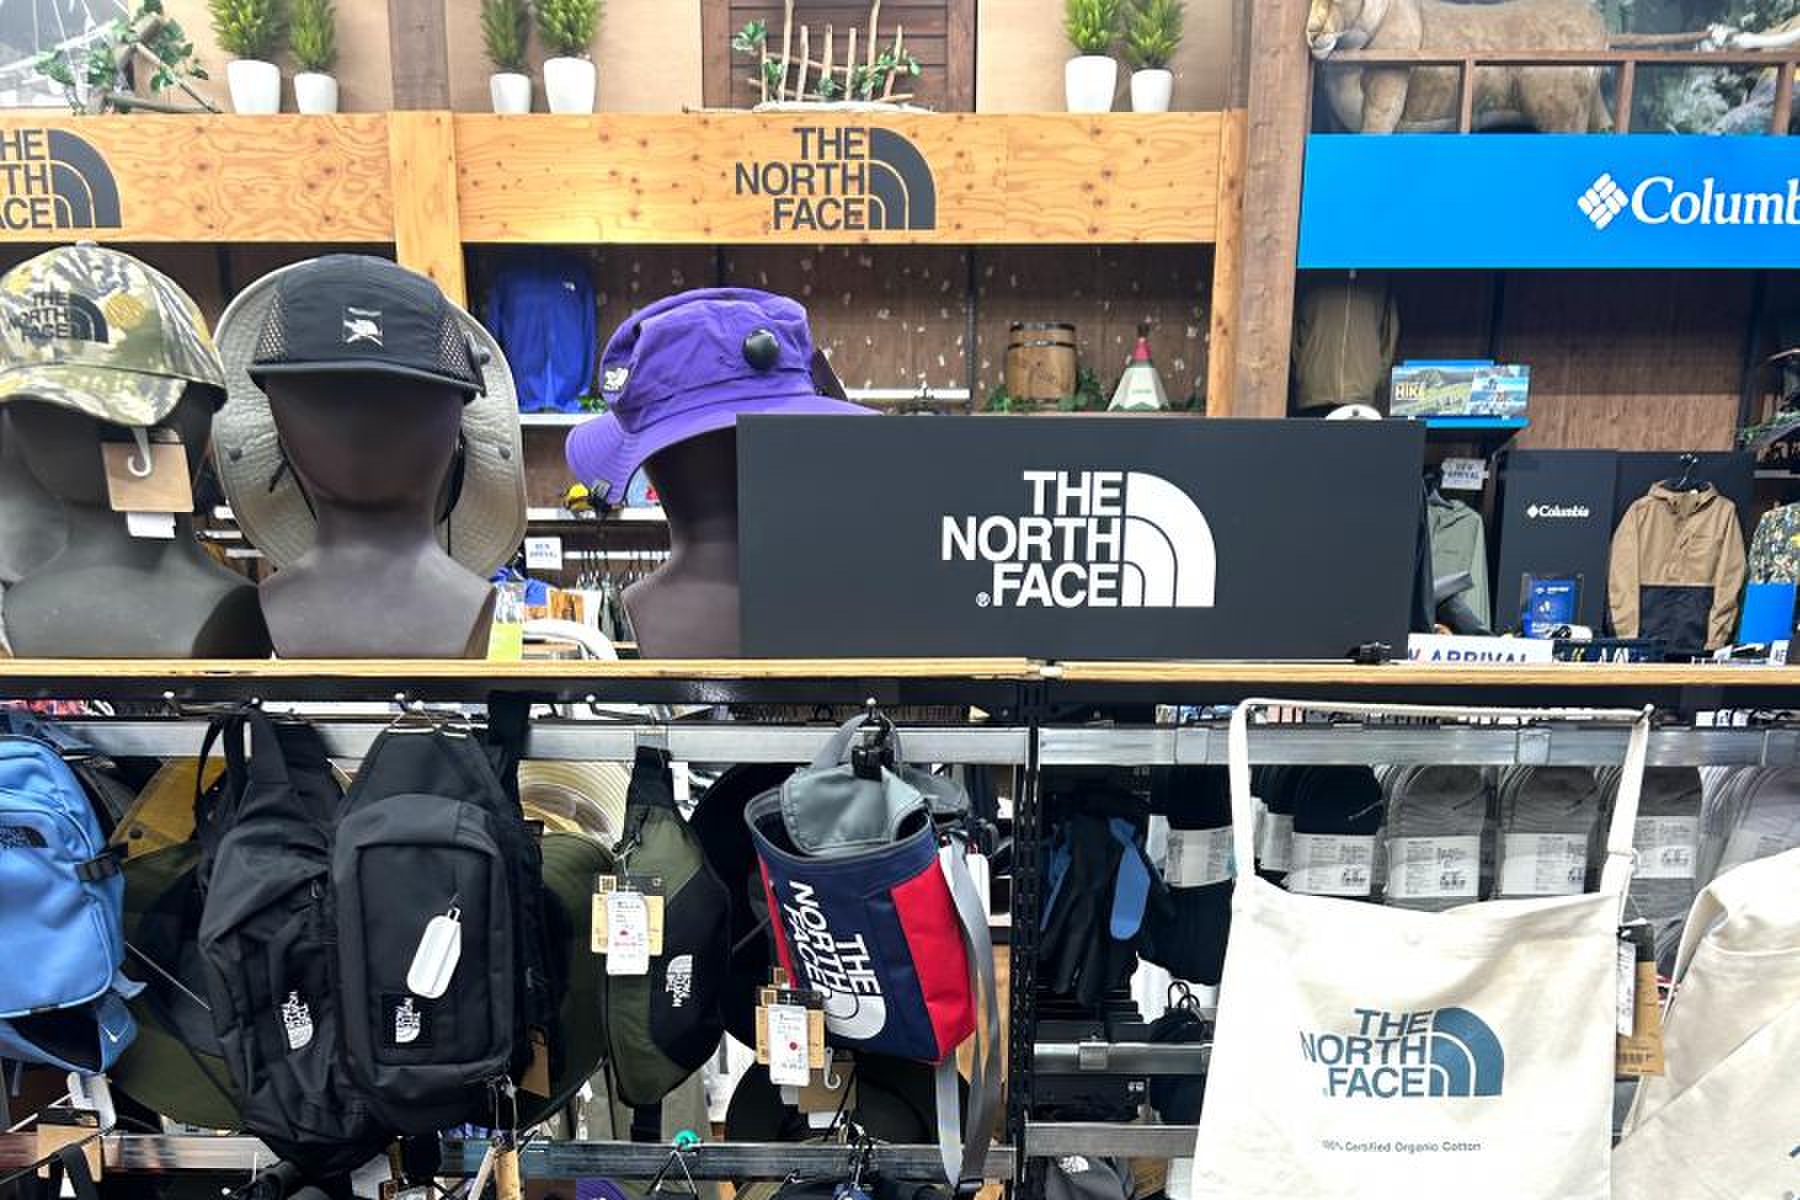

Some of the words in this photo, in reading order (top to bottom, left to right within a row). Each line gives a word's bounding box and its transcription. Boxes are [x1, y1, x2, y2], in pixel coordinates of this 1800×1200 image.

[793, 127, 866, 160] THE
[735, 161, 866, 195] NORTH
[0, 197, 52, 230] CE
[773, 197, 866, 230] FACE
[1023, 470, 1123, 516] THE
[941, 515, 1121, 561] NORTH
[992, 562, 1119, 608] FACE
[783, 902, 833, 992] FACE
[788, 879, 850, 993] NORTH
[835, 933, 881, 995] THE
[1354, 1007, 1434, 1037] THE
[1299, 1029, 1426, 1065] NORTH
[1328, 1066, 1425, 1098] FACE
[1345, 1141, 1391, 1152] Certified
[1395, 1142, 1439, 1154] Organic
[1442, 1141, 1481, 1151] Cotton
